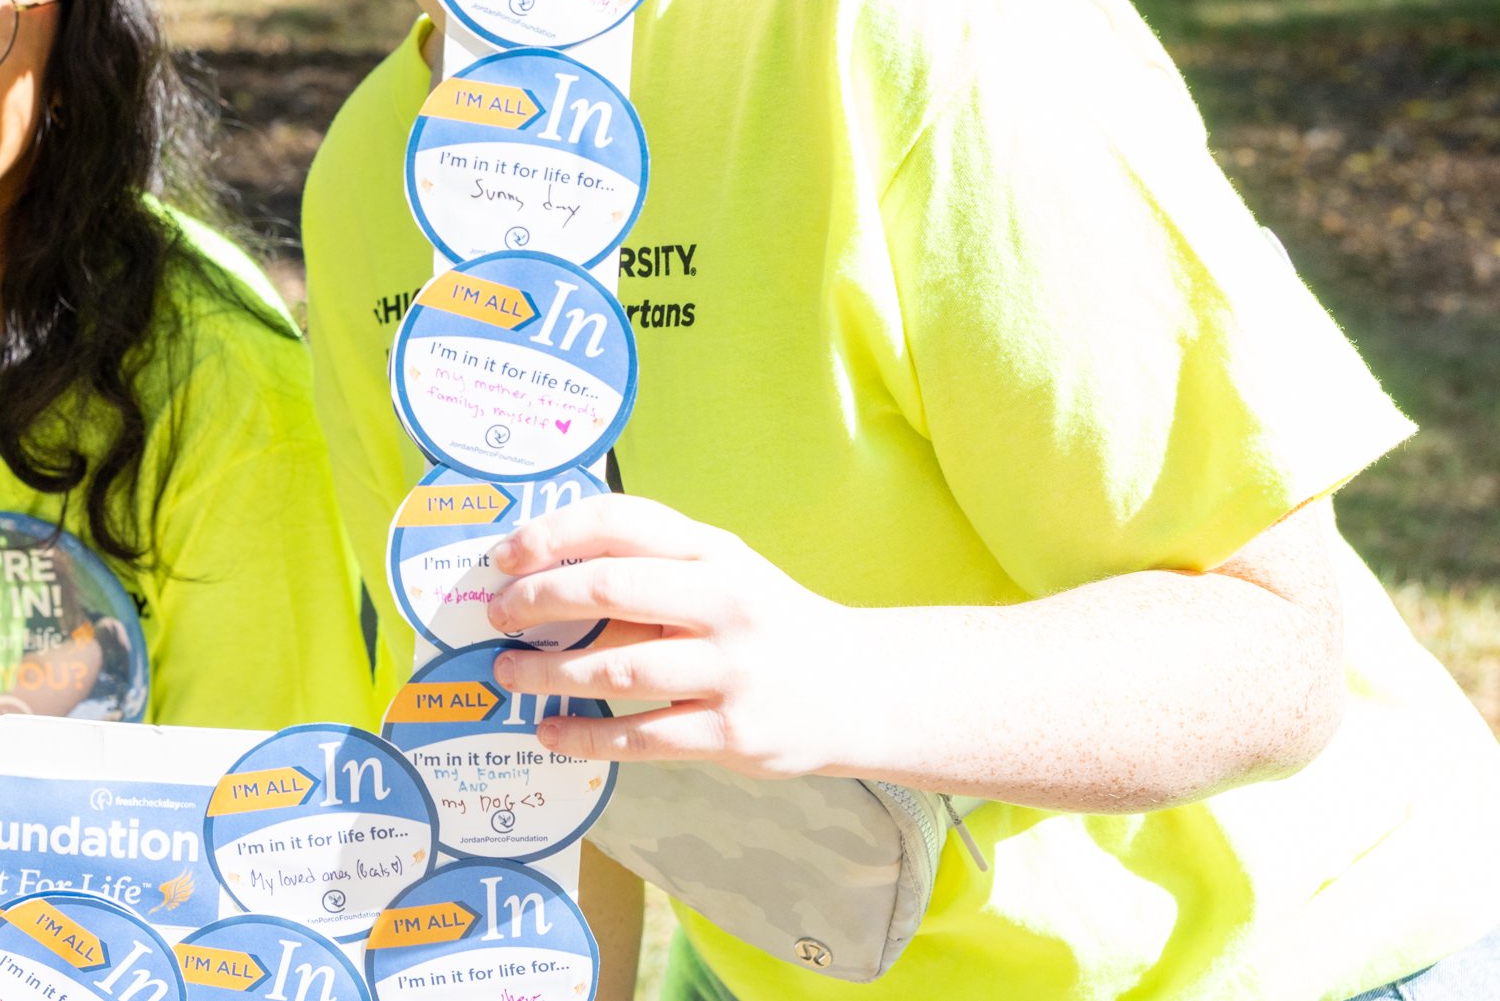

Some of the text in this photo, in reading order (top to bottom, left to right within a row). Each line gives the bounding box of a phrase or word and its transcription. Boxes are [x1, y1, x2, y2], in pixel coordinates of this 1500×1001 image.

[454, 72, 614, 149] I'M ALL In
[621, 301, 696, 330] rtans
[492, 405, 551, 430] myself
[11, 585, 63, 619] IN!
[433, 768, 459, 782] my
[457, 780, 488, 793] AND
[441, 797, 467, 815] my
[459, 834, 549, 845] JordanPorcoFoundation
[16, 868, 74, 897] For
[277, 867, 316, 887] loved
[321, 868, 352, 883] ones
